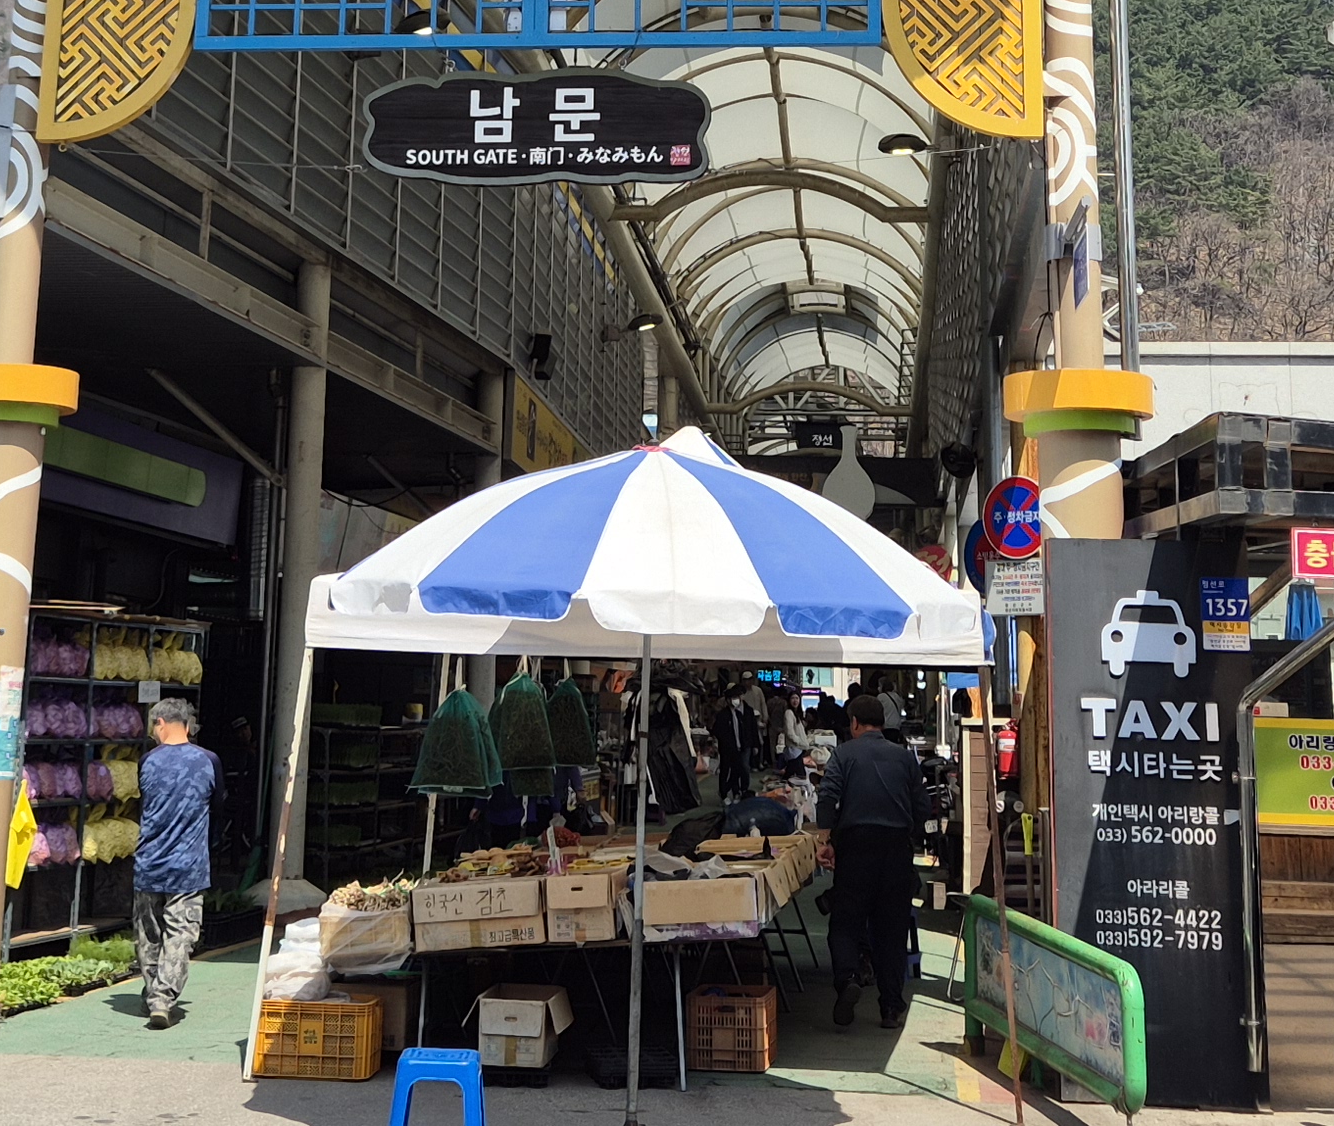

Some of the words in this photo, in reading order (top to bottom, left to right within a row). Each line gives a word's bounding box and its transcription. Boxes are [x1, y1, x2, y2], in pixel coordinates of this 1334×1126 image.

[406, 149, 468, 165] SOUTH
[1206, 598, 1248, 616] 1357
[1080, 698, 1220, 742] TAXI
[1092, 804, 1153, 823] 개인택시
[1158, 806, 1220, 826] 아리랑콜
[1096, 828, 1127, 842] 033)
[1131, 826, 1217, 846] 562-0000
[1127, 879, 1190, 900] 아라리콜
